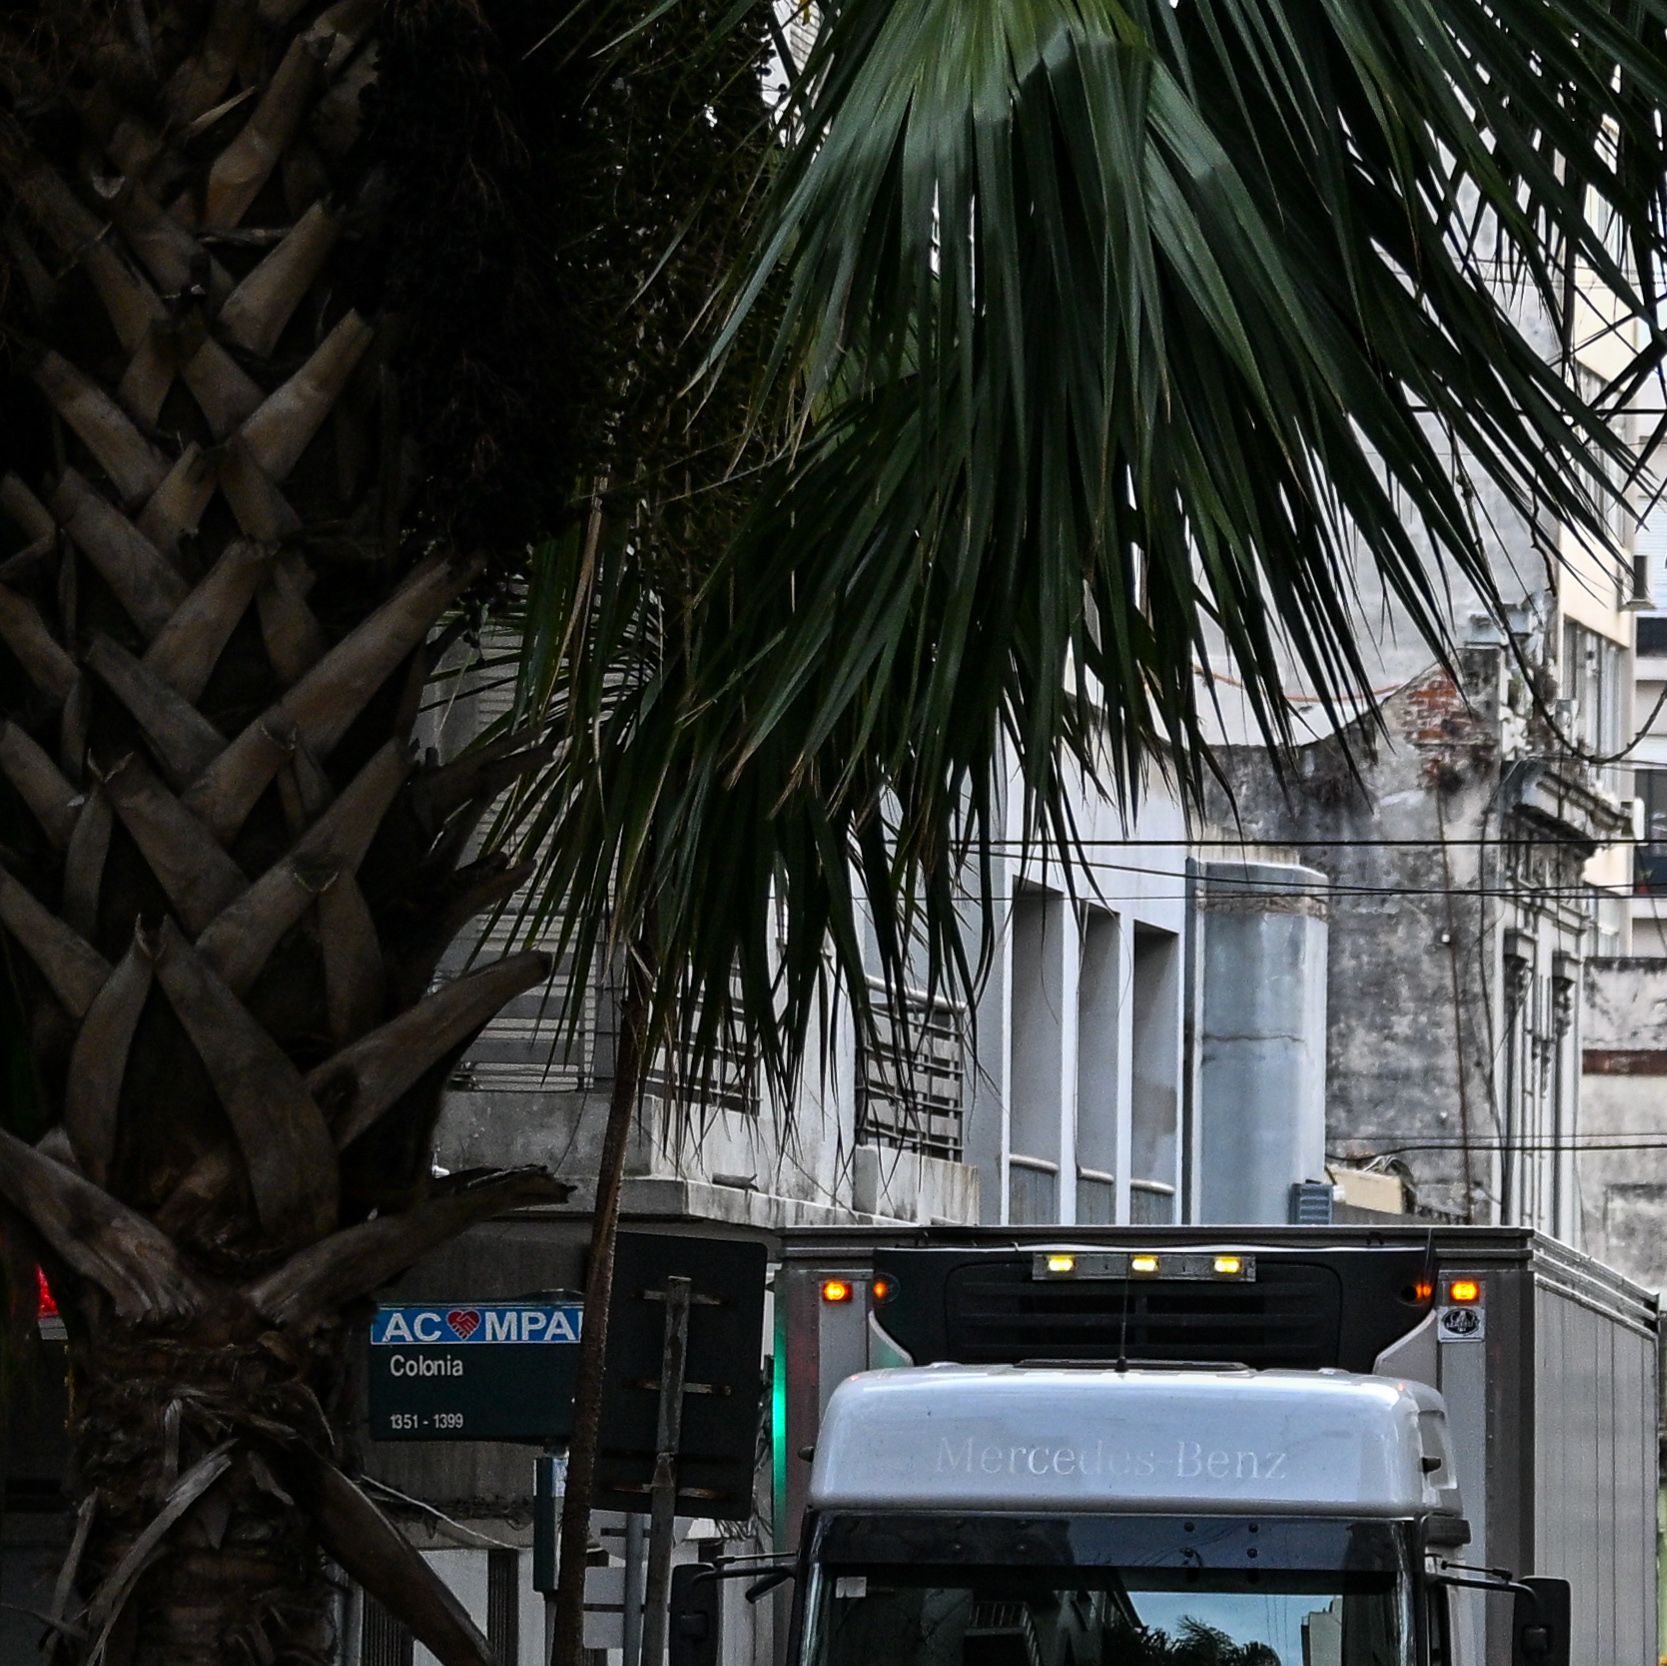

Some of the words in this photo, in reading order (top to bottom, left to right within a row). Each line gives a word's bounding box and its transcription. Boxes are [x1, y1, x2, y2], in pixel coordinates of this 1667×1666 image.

[390, 1355, 464, 1377] Colonia
[390, 1414, 419, 1429] 1351
[433, 1413, 464, 1429] 1399
